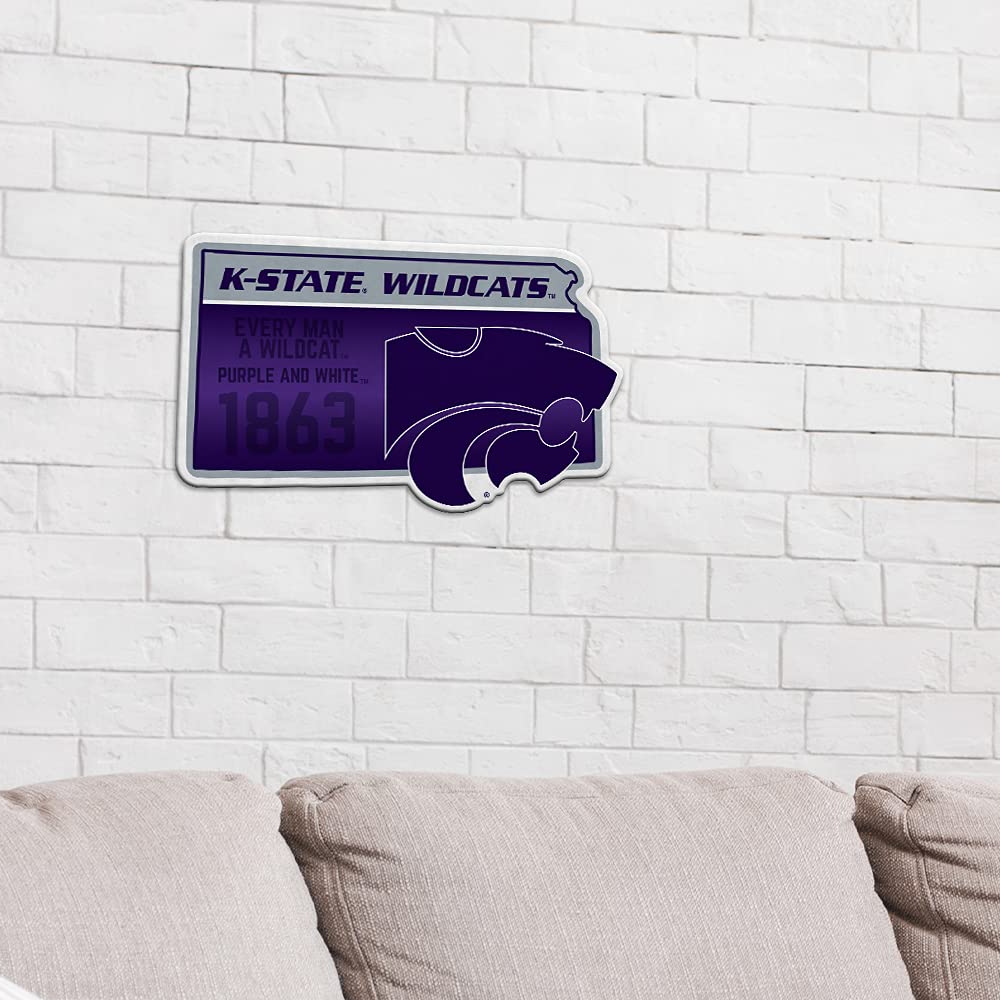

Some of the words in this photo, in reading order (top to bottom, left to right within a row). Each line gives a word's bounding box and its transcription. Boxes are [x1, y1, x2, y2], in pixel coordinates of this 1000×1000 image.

[219, 267, 365, 294] K-STATE
[384, 272, 549, 299] WILDCATS
[234, 317, 296, 337] EVERY
[303, 319, 344, 339] MAN
[239, 338, 251, 358] A
[260, 339, 340, 359] WILDCAT
[218, 367, 274, 383] PURPLE
[280, 368, 310, 383] AND
[315, 368, 359, 384] WHITE
[219, 391, 355, 456] 1863
